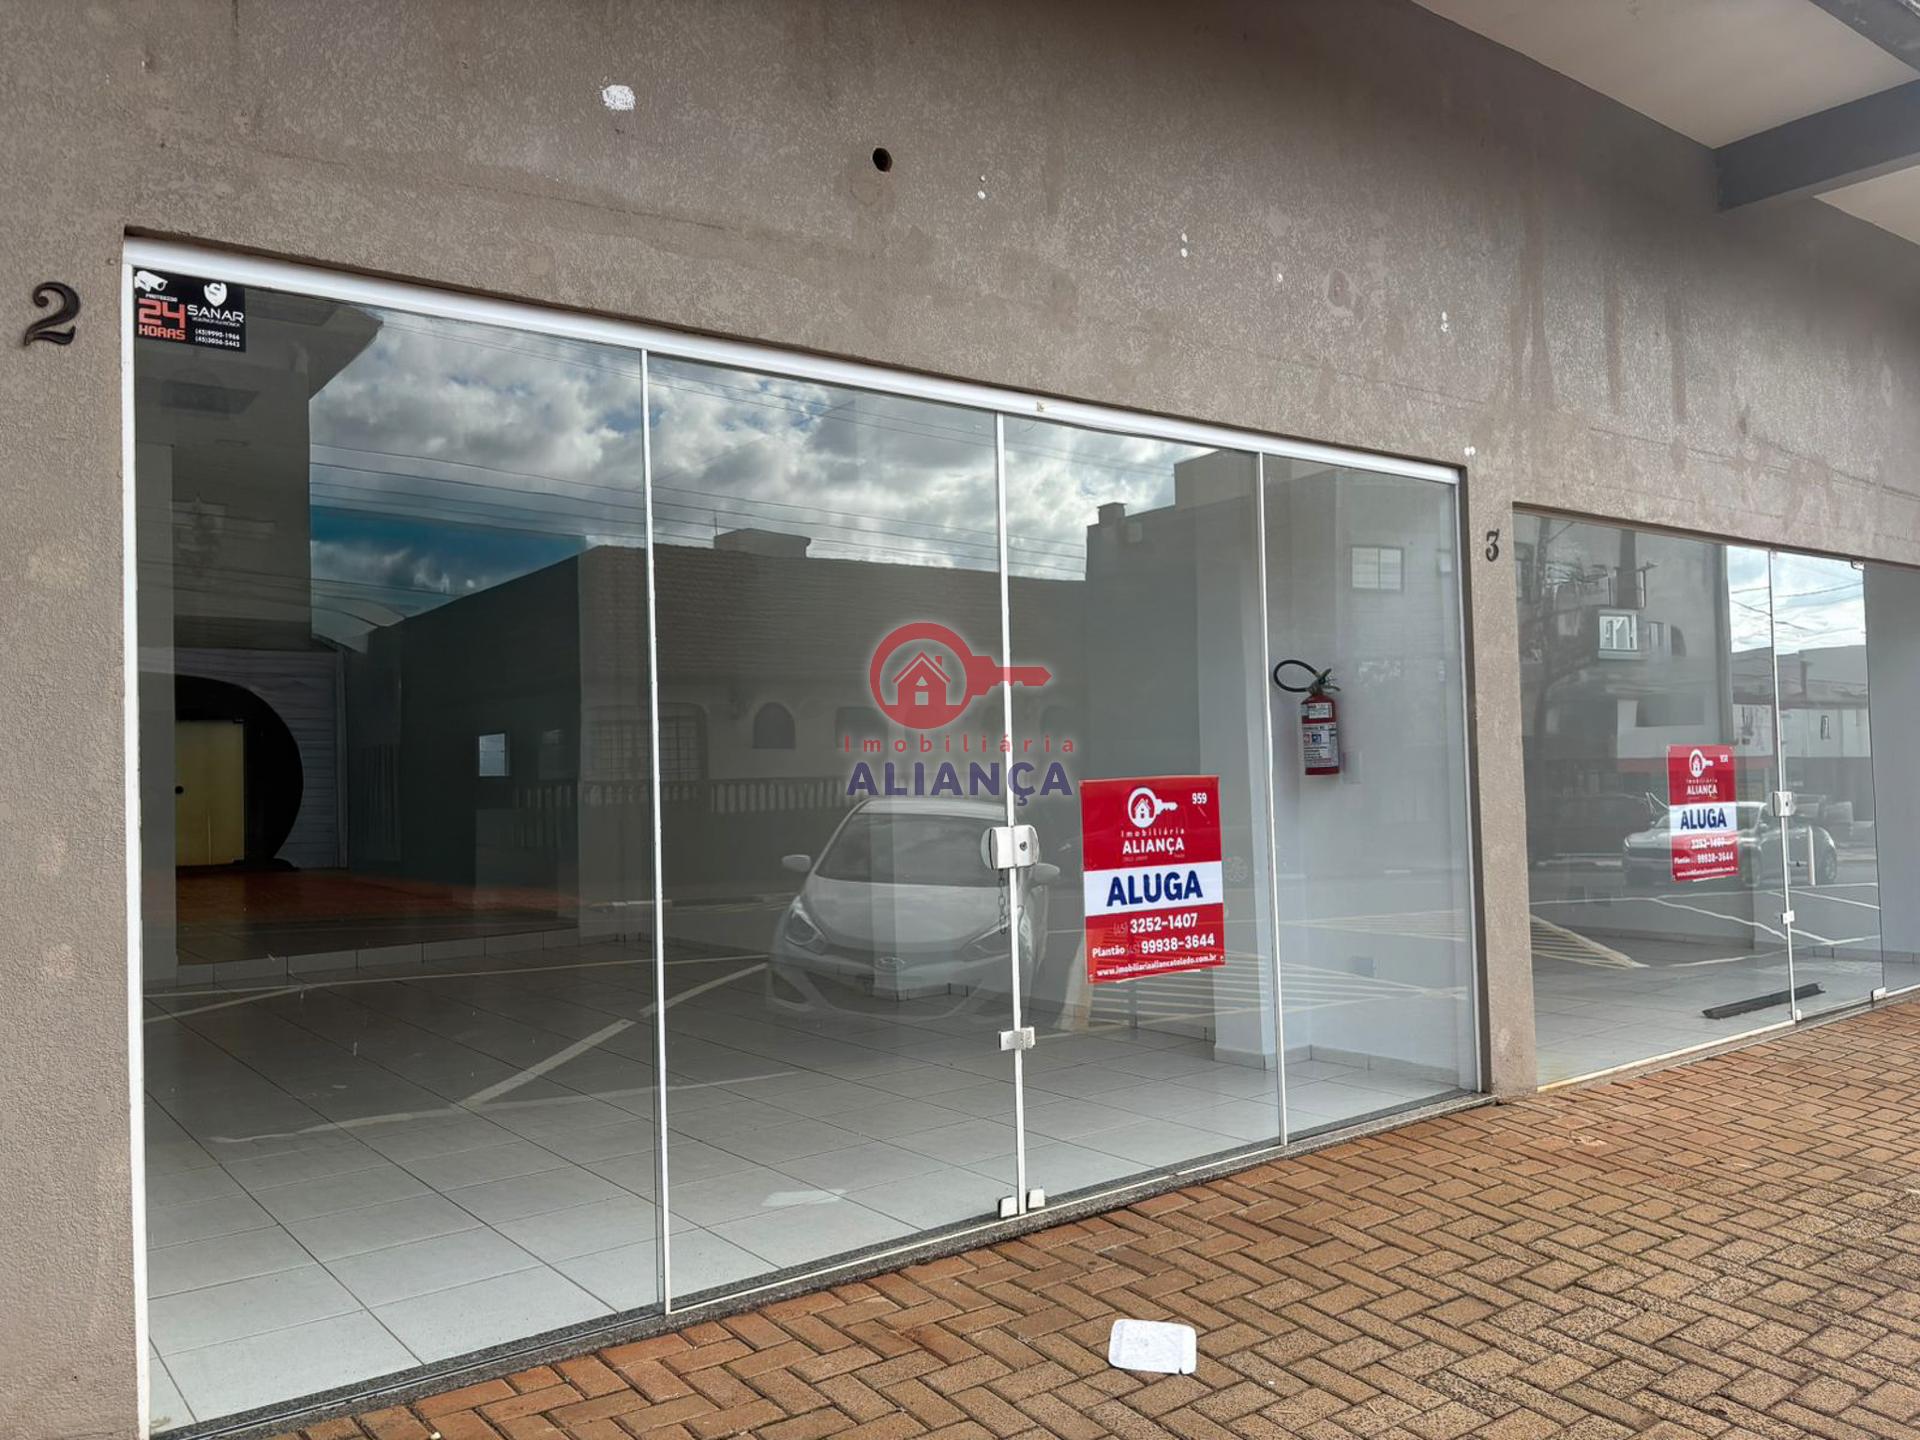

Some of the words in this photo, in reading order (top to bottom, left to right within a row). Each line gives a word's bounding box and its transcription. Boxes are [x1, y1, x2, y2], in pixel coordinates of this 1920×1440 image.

[24, 281, 81, 346] 2
[138, 298, 186, 329] 24
[187, 304, 245, 323] SANAR
[138, 324, 186, 340] HORAS
[1485, 528, 1500, 562] 3
[1192, 792, 1208, 805] 959
[1686, 785, 1718, 797] ALIANÇA
[1680, 808, 1727, 830] ALUGA
[1122, 836, 1185, 855] ALIANÇA
[1106, 870, 1204, 907] ALUGA
[1130, 912, 1198, 934] 3252-1407
[1092, 945, 1126, 957] Plantão
[1141, 933, 1215, 954] 99938-3644
